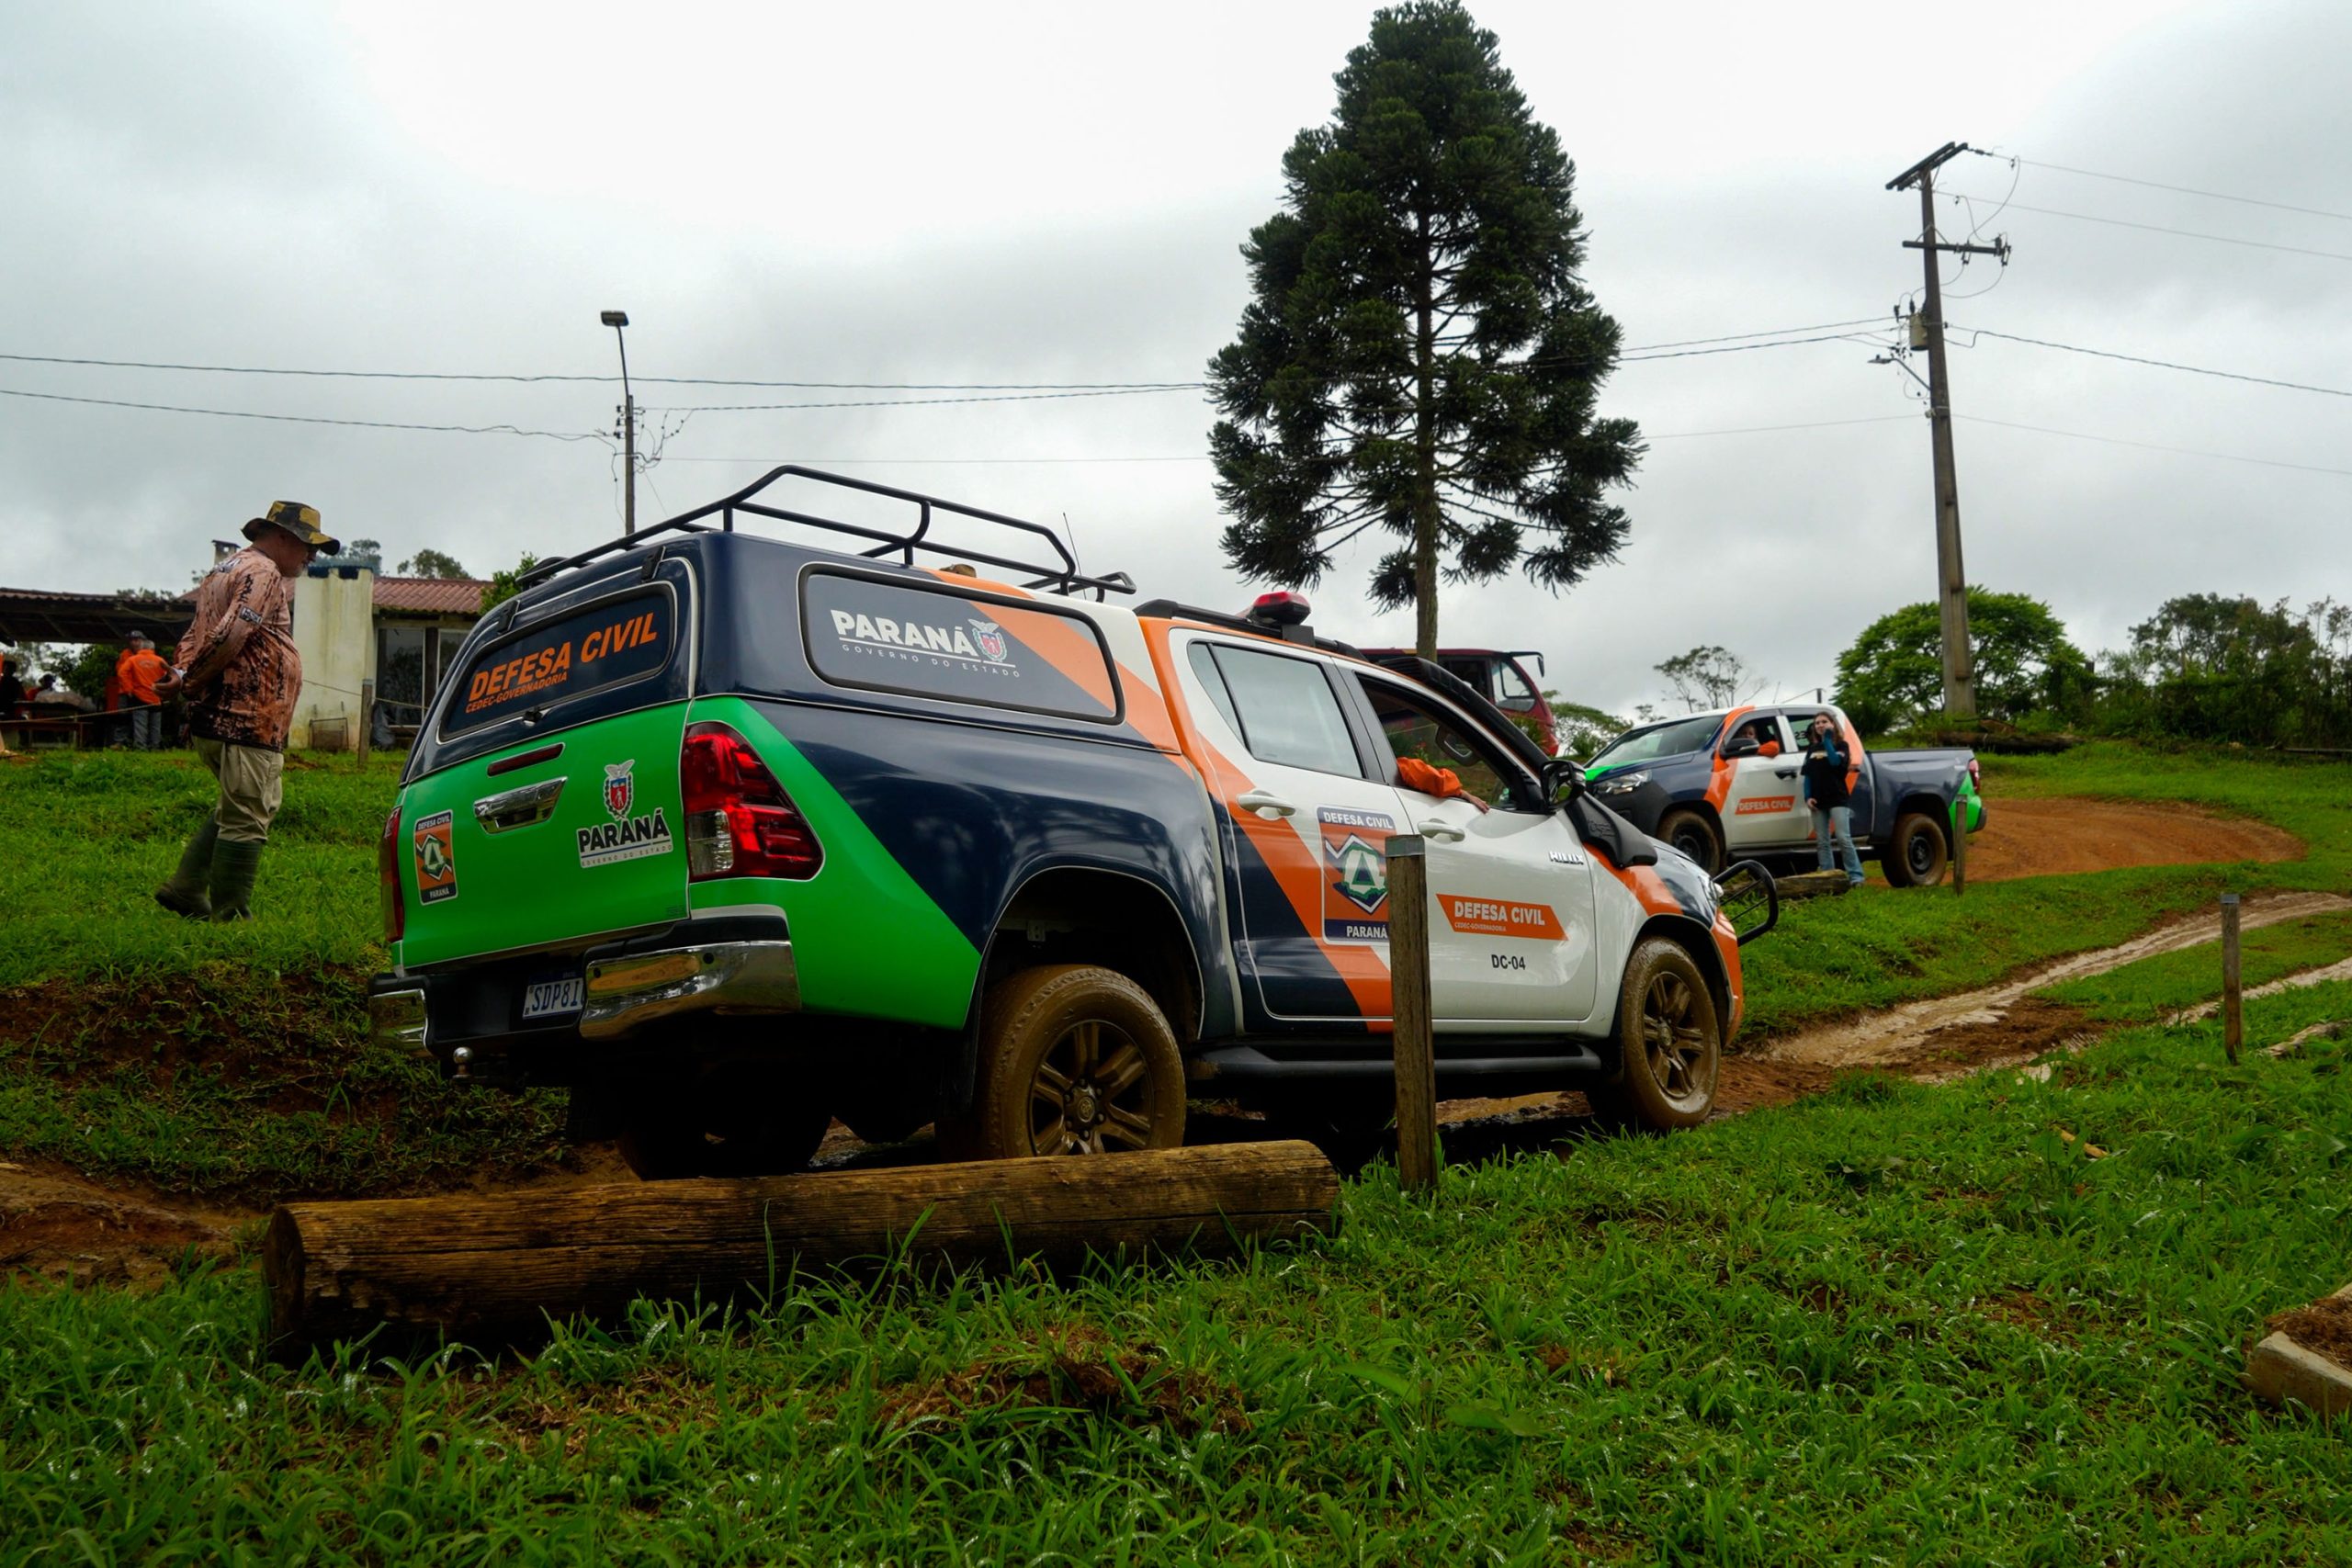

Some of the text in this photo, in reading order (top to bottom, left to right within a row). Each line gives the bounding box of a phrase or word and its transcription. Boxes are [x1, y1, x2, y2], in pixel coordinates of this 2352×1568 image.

[830, 609, 979, 657] PARANÁ
[469, 613, 658, 702] DEFESA CIVIL
[842, 644, 1020, 678] GOVERNO DO ESTADO
[465, 671, 568, 713] CEDEC-GOVERNADORIA
[1738, 798, 1792, 811] DEFESA CIVIL
[417, 814, 450, 830] DEFESA CIVIL
[578, 808, 670, 853] PARANÁ
[1323, 811, 1394, 829] DEFESA CIVIL
[1549, 851, 1584, 865] HILUX
[1454, 900, 1545, 926] DEFESA CIVIL
[1346, 924, 1388, 940] PARANÁ
[1491, 954, 1526, 970] DC-04
